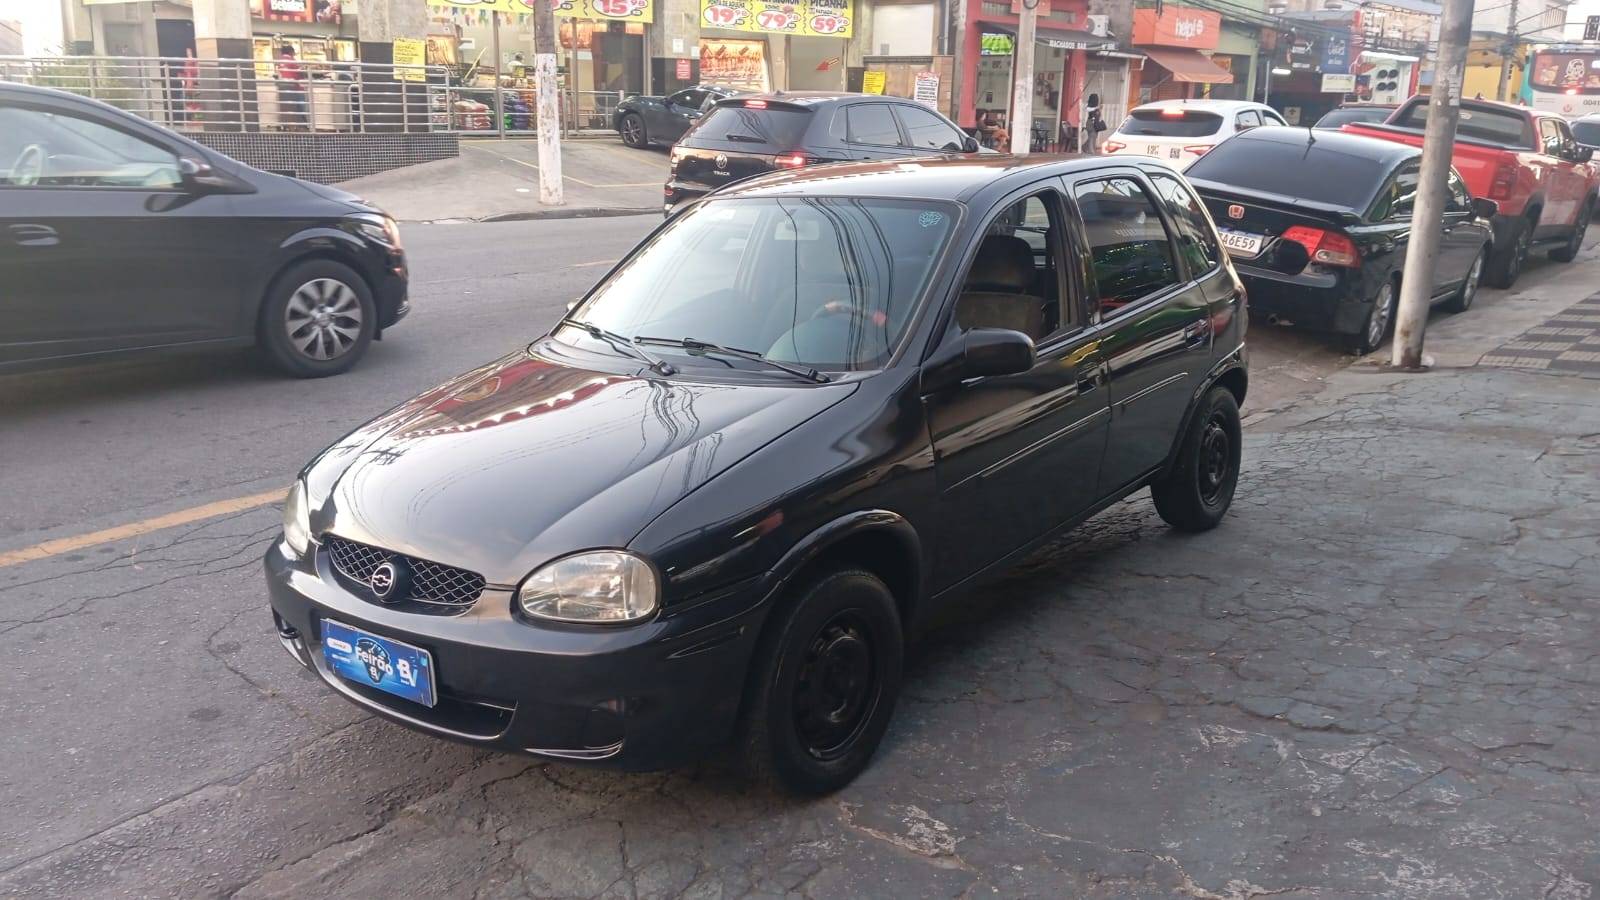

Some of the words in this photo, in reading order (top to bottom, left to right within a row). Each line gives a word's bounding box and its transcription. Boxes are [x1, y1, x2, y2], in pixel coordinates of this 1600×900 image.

[810, 0, 848, 9] PICANHA
[710, 7, 734, 22] 19
[761, 13, 786, 27] 79
[814, 17, 836, 31] 59
[355, 646, 393, 676] Feirão
[397, 658, 418, 687] BV
